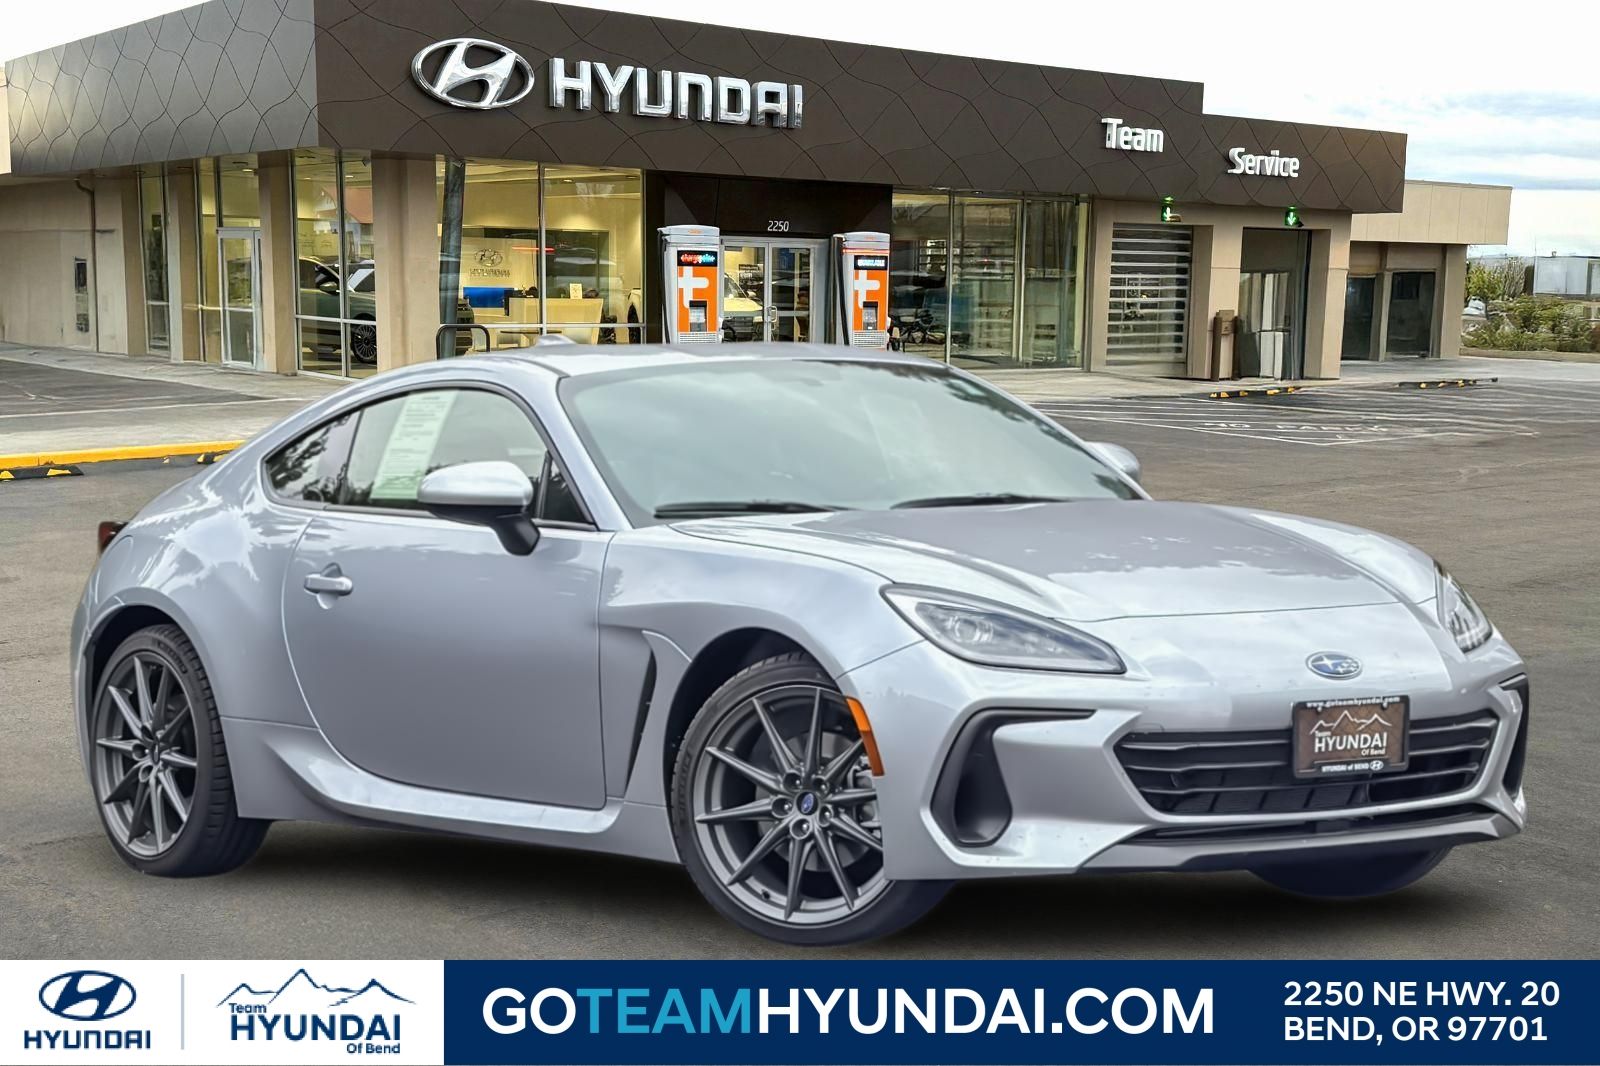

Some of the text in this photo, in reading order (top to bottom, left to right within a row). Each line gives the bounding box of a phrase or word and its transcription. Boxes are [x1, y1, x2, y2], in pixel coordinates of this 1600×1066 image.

[549, 57, 803, 129] HYUNDAI
[1101, 117, 1164, 152] Team
[1227, 147, 1300, 178] Service
[767, 220, 790, 232] 2250
[1314, 732, 1387, 753] HYUNDAI
